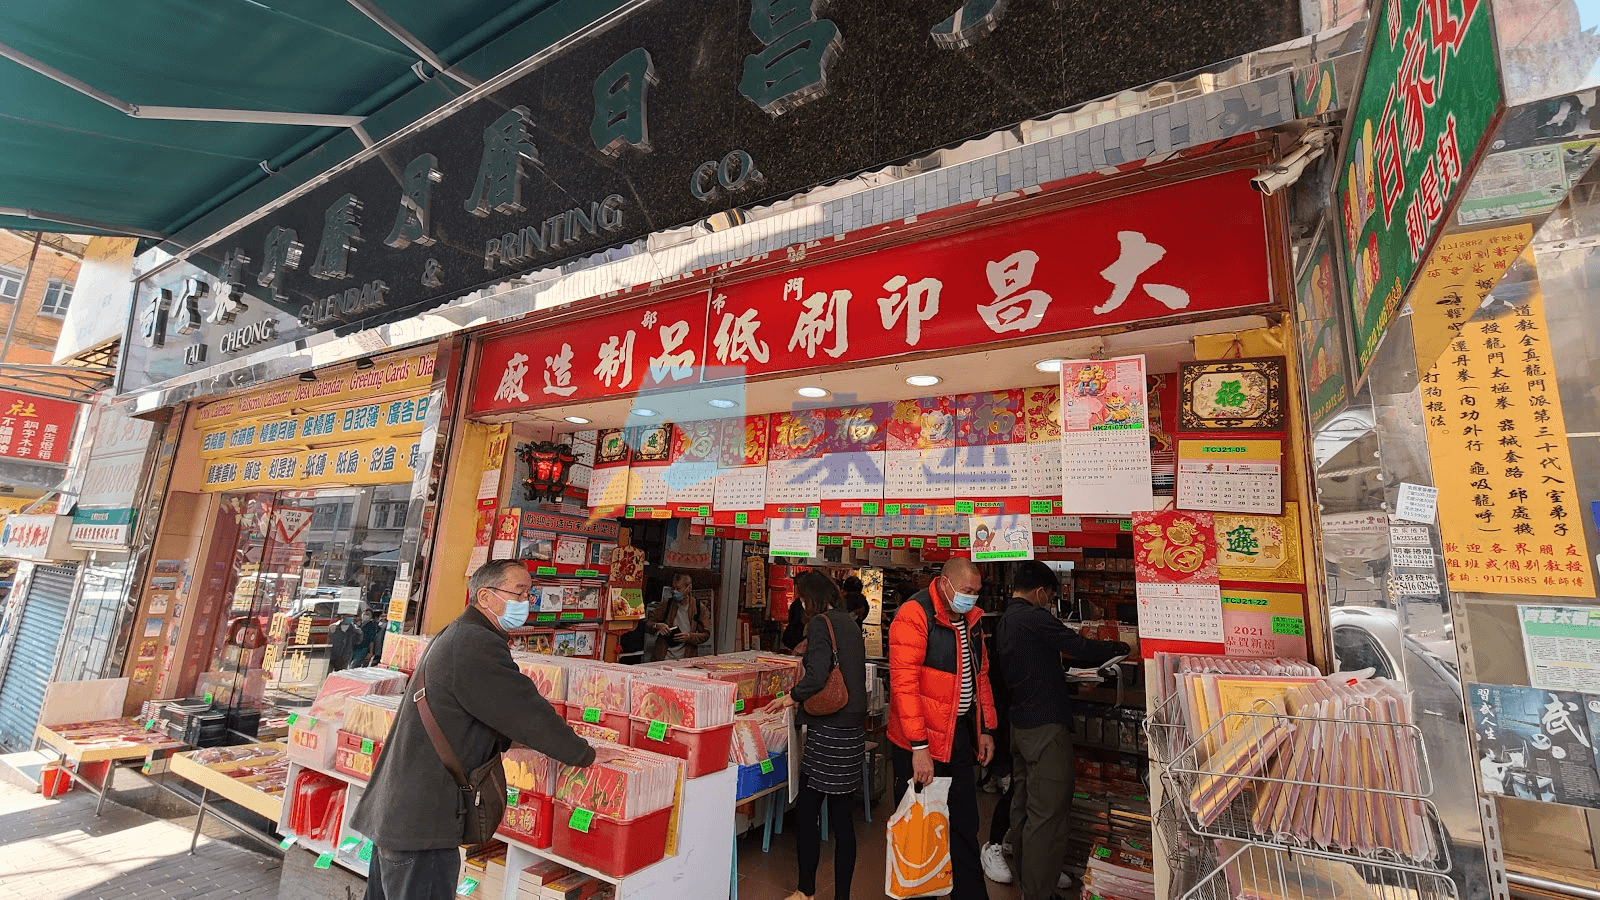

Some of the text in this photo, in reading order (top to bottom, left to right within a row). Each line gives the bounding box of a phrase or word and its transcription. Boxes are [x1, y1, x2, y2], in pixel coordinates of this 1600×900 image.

[183, 343, 206, 366] TAI
[219, 318, 276, 355] CHEONG
[298, 279, 390, 328] CALENDAR
[420, 257, 444, 288] &
[484, 193, 624, 271] PRINTING
[691, 149, 764, 200] CO.
[312, 376, 345, 398] Calendar
[349, 366, 384, 391] Greeting
[386, 360, 410, 383] Cards
[342, 405, 380, 432] 日記簿
[369, 445, 397, 472] 彩盒
[1483, 574, 1537, 584] 91715885
[1234, 626, 1263, 636] 2021
